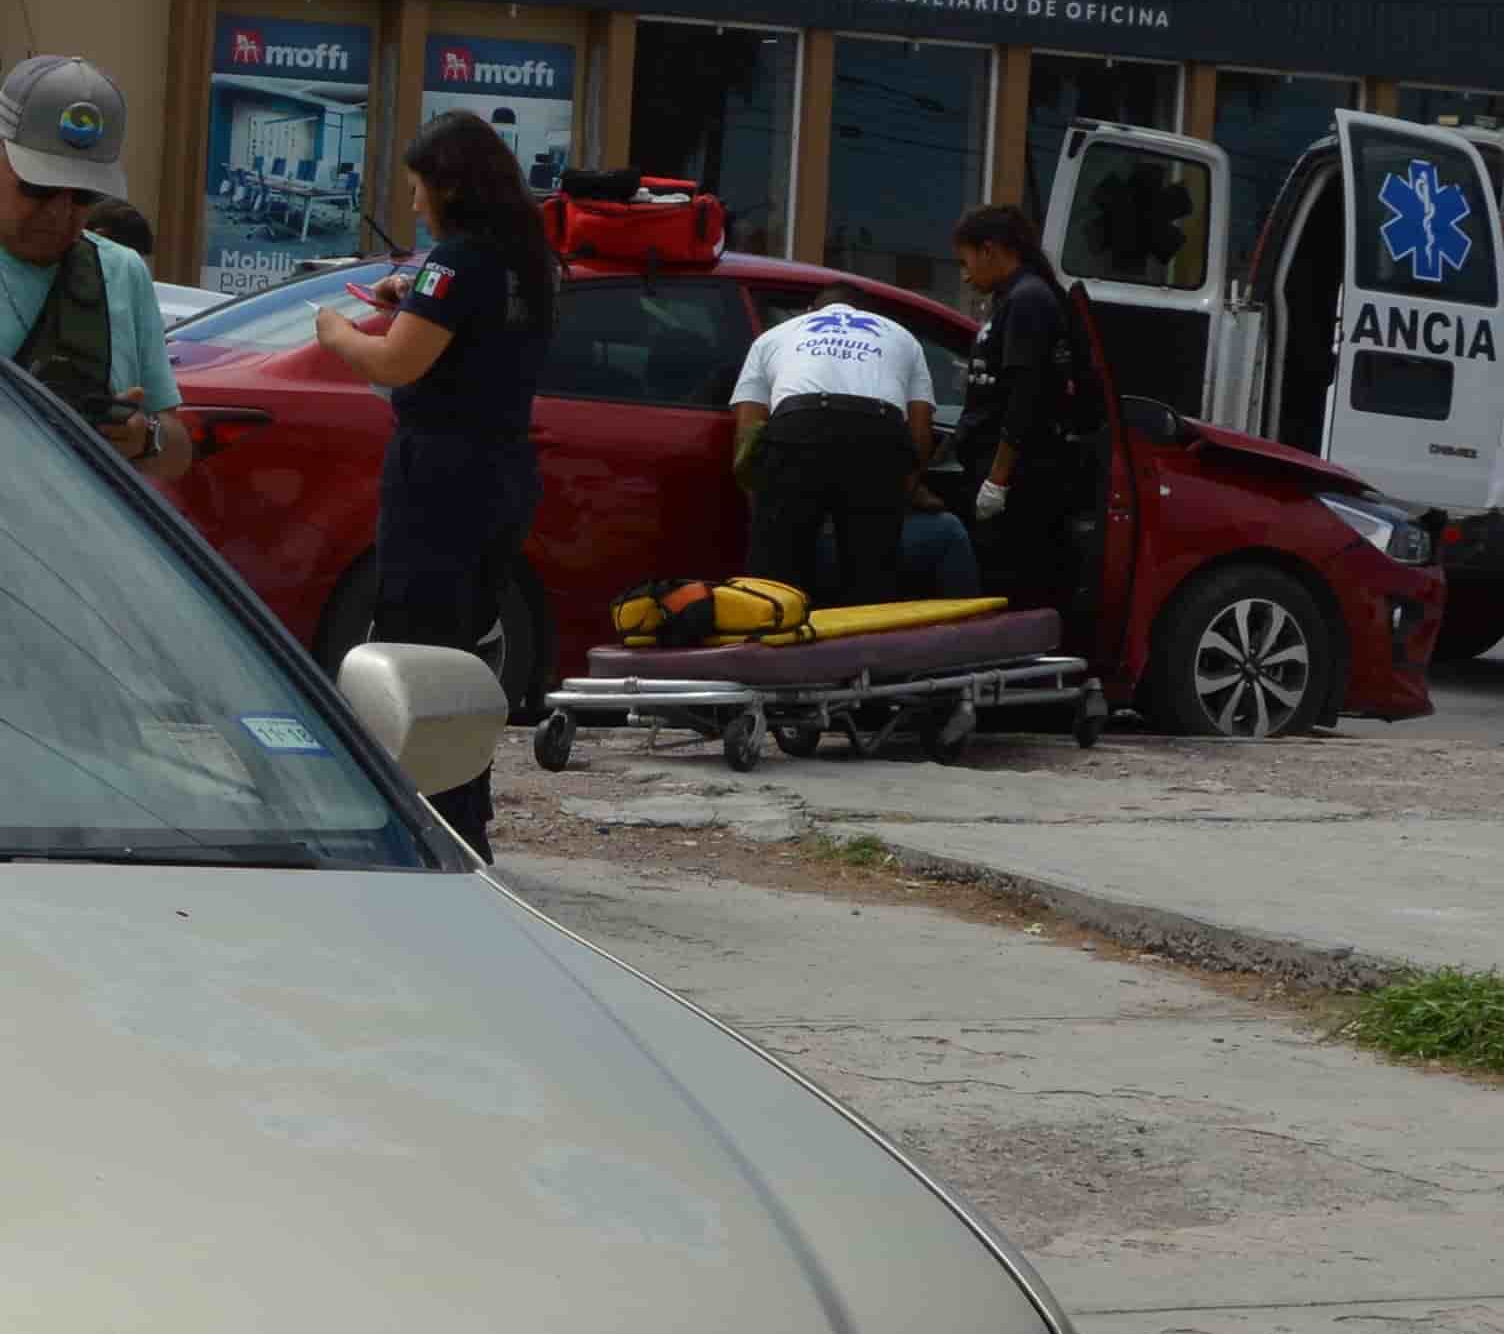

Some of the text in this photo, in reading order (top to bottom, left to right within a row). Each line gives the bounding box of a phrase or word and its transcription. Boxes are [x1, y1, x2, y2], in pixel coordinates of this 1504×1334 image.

[1065, 1, 1170, 28] OFICINA
[265, 43, 349, 72] moffi
[473, 59, 555, 88] moffi
[221, 250, 295, 273] Mobili
[1350, 302, 1497, 362] ANCIA
[795, 336, 883, 357] COAHUILA
